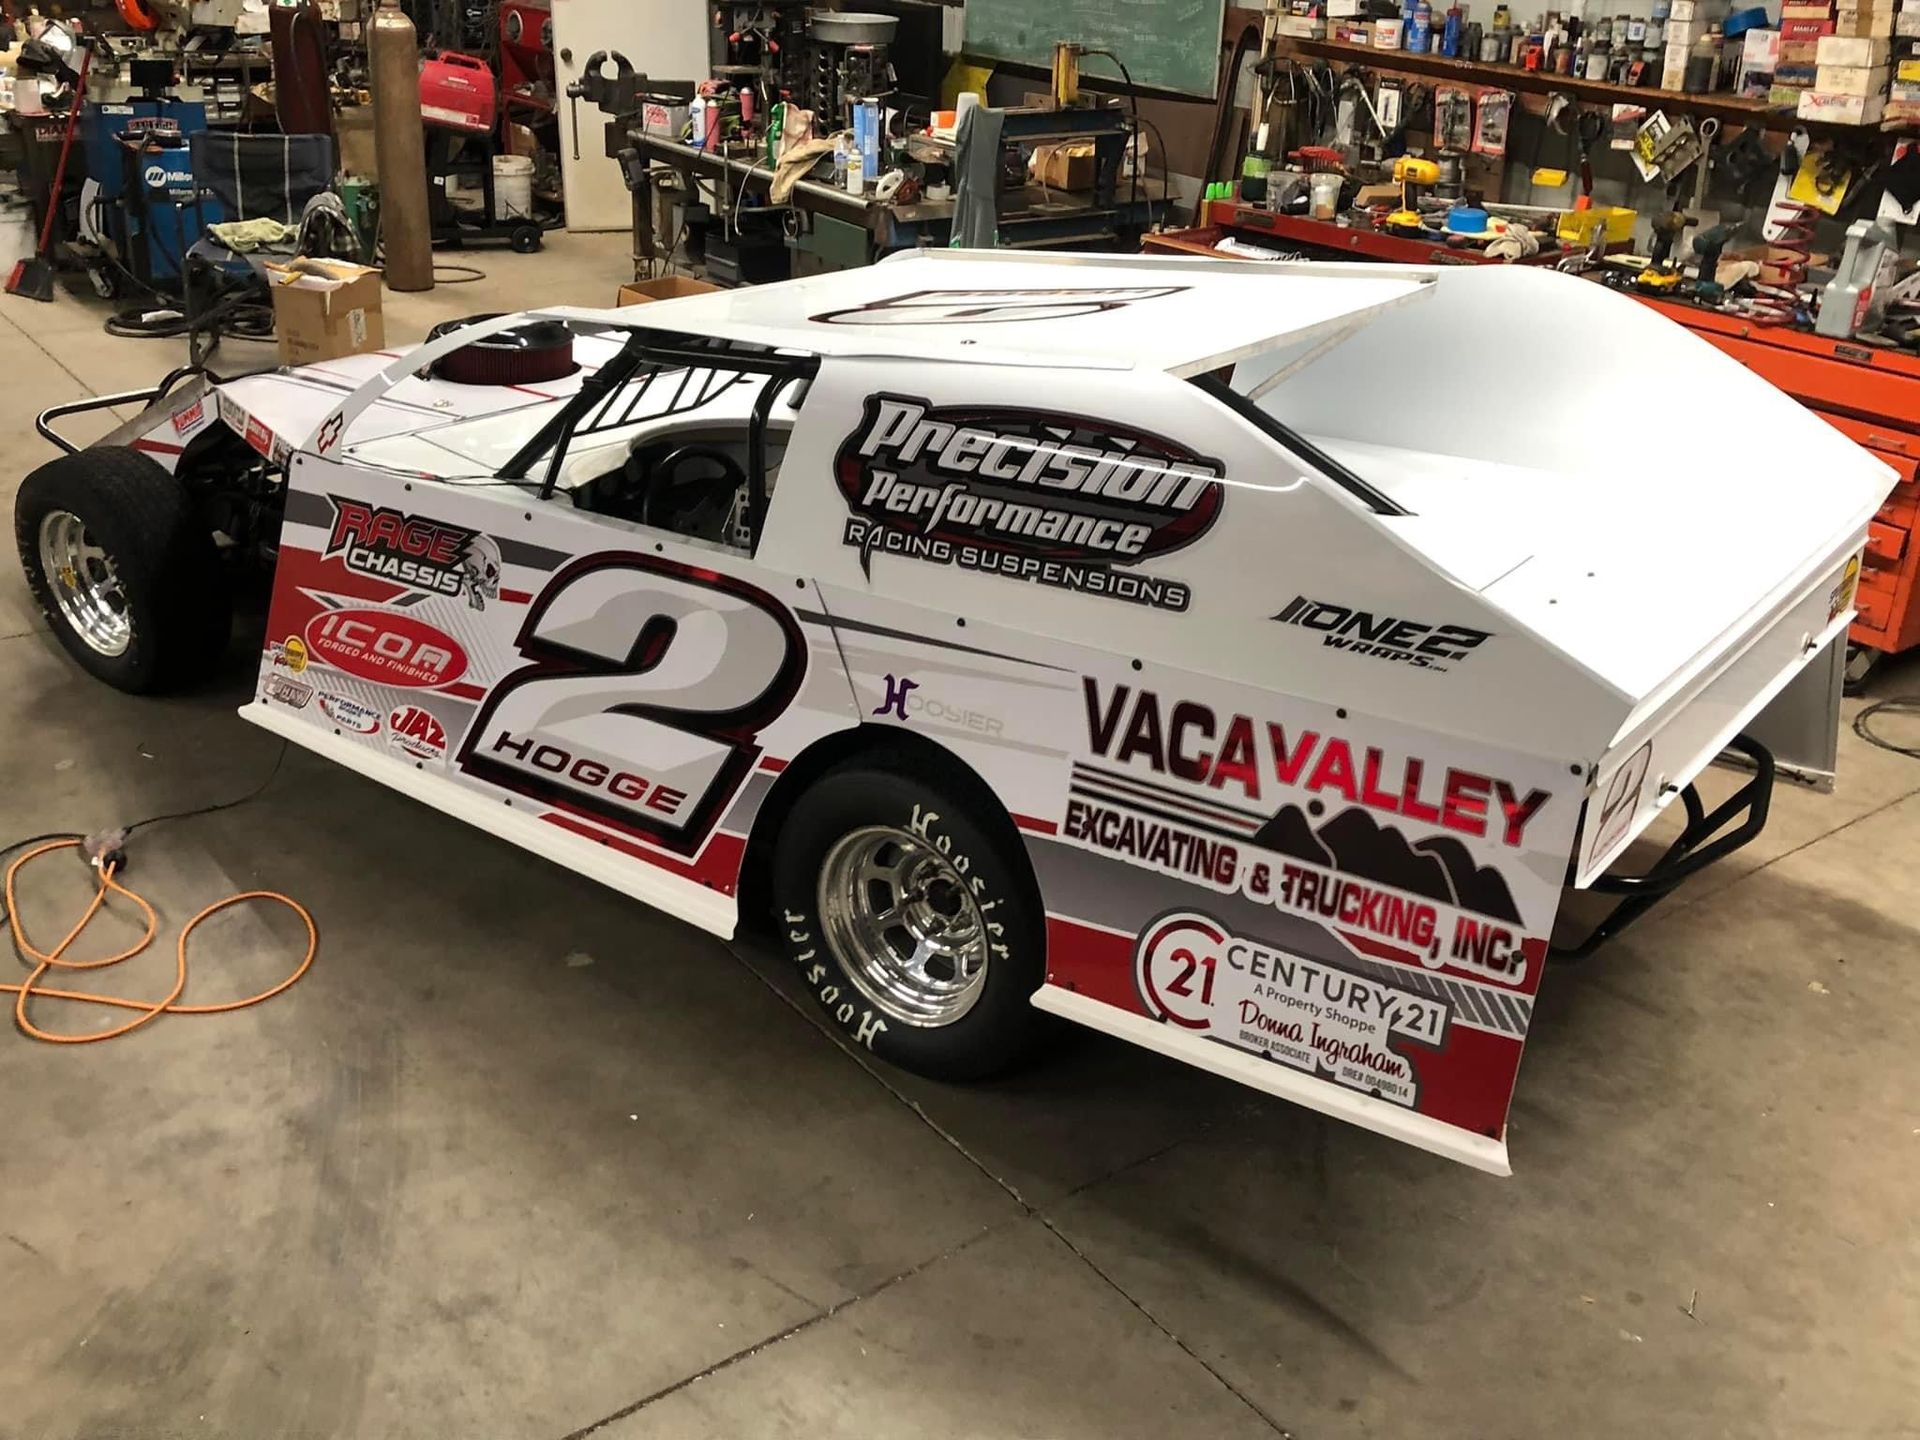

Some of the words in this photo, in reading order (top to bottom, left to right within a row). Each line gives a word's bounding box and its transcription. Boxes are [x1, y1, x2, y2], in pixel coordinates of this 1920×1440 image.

[858, 399, 1215, 510] Precision
[333, 501, 468, 563] RAGE
[861, 470, 1152, 556] Performance
[349, 548, 462, 593] CHASSIS
[847, 524, 951, 580] RACING
[961, 546, 1186, 608] SUSPENSIONS
[317, 638, 360, 657] FORGED
[361, 653, 384, 665] AND
[386, 660, 438, 683] FINISHED
[321, 615, 452, 674] ICON
[318, 691, 381, 720] PERFORMANCE
[336, 715, 362, 729] PARTS
[391, 707, 446, 749] JAZ
[458, 551, 807, 858] 2
[872, 673, 1004, 735] HOOSIER
[492, 731, 688, 815] HOGGE
[901, 804, 1010, 960] Hoosier
[1063, 799, 1238, 885] EXCAVATING
[1250, 863, 1270, 895] &
[1282, 863, 1441, 960] TRUCKING,
[1227, 945, 1397, 1019] CENTURY
[1405, 1003, 1439, 1036] 21
[1254, 983, 1263, 996] A
[1267, 987, 1322, 1017] Property
[1325, 1008, 1376, 1034] Shoppe
[1239, 999, 1304, 1043] Donna
[1309, 1022, 1406, 1079] Ingraham
[1239, 1030, 1270, 1048] BROKER
[1270, 1040, 1311, 1064] ASSOCIATE
